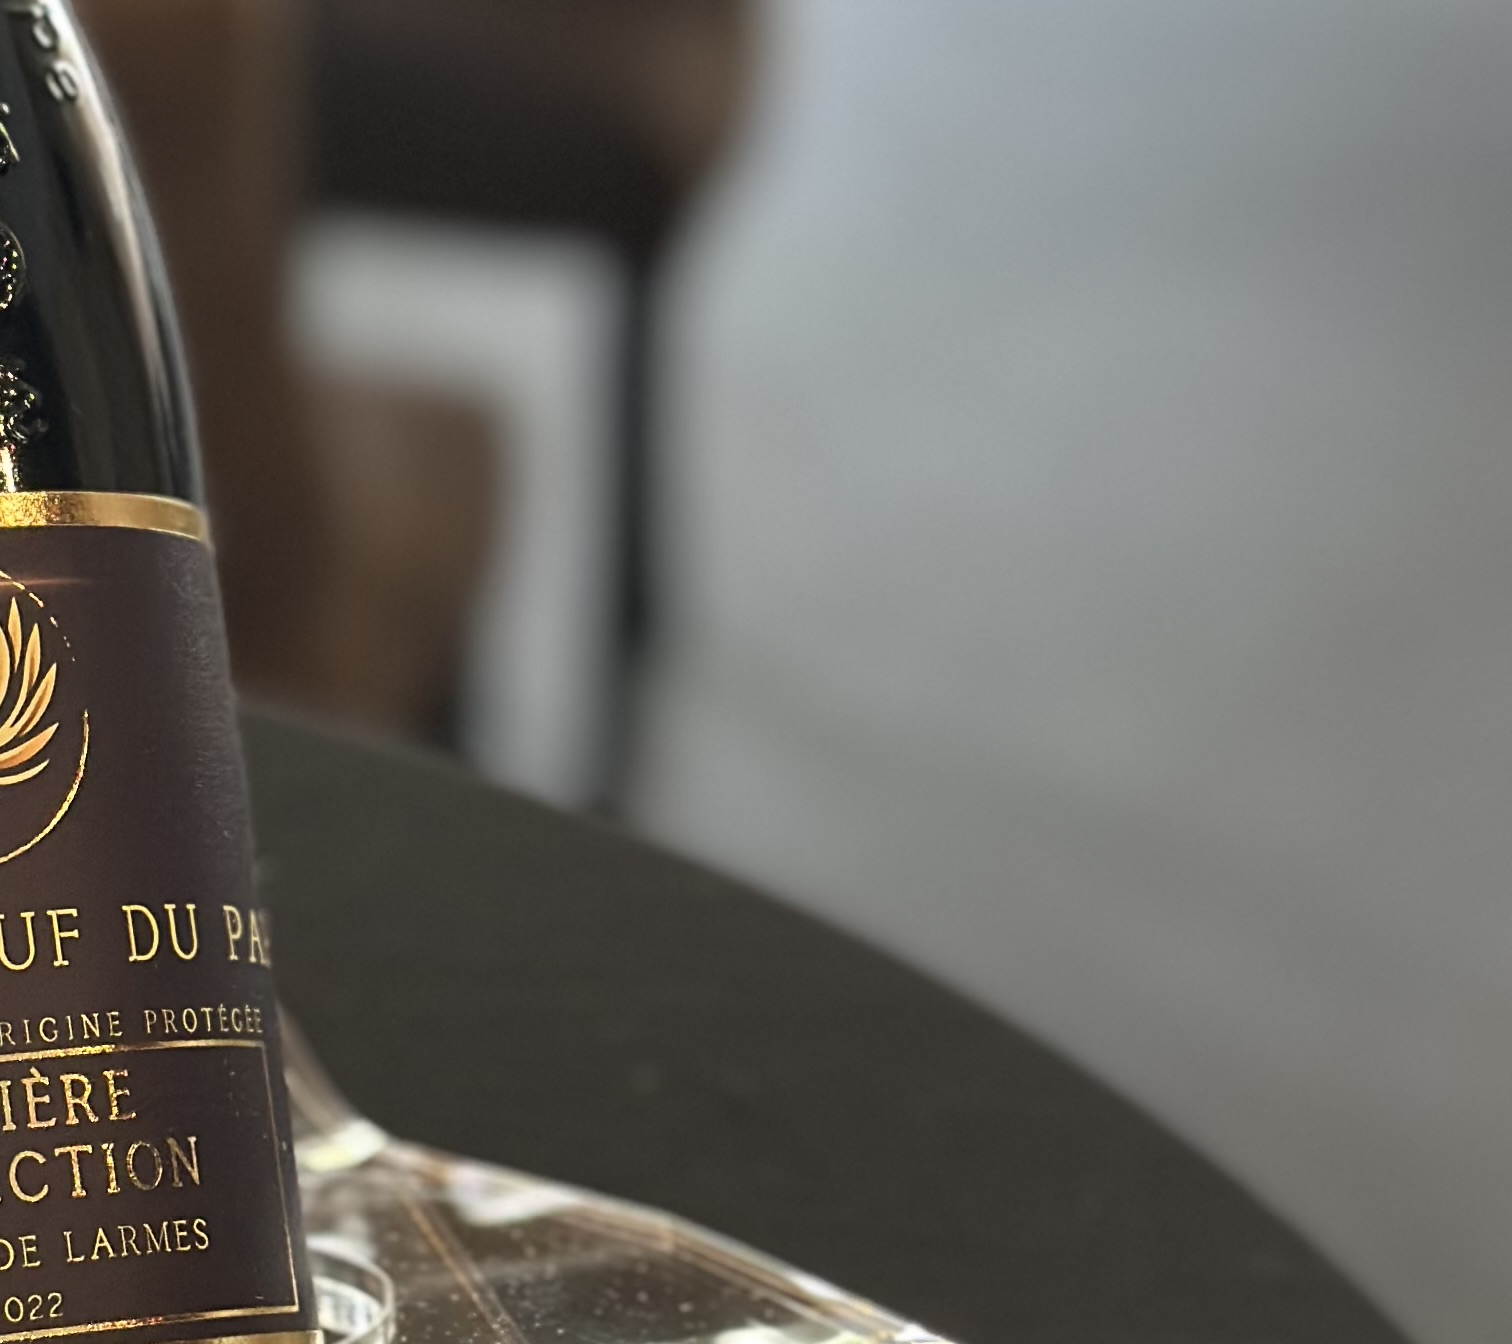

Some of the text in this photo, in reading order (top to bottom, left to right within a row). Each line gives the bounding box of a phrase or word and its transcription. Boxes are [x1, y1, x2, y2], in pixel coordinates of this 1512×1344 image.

[121, 903, 199, 963] DU
[221, 904, 272, 968] PA
[143, 1003, 264, 1034] PROTÉGÉE
[62, 1218, 210, 1264] LARMES
